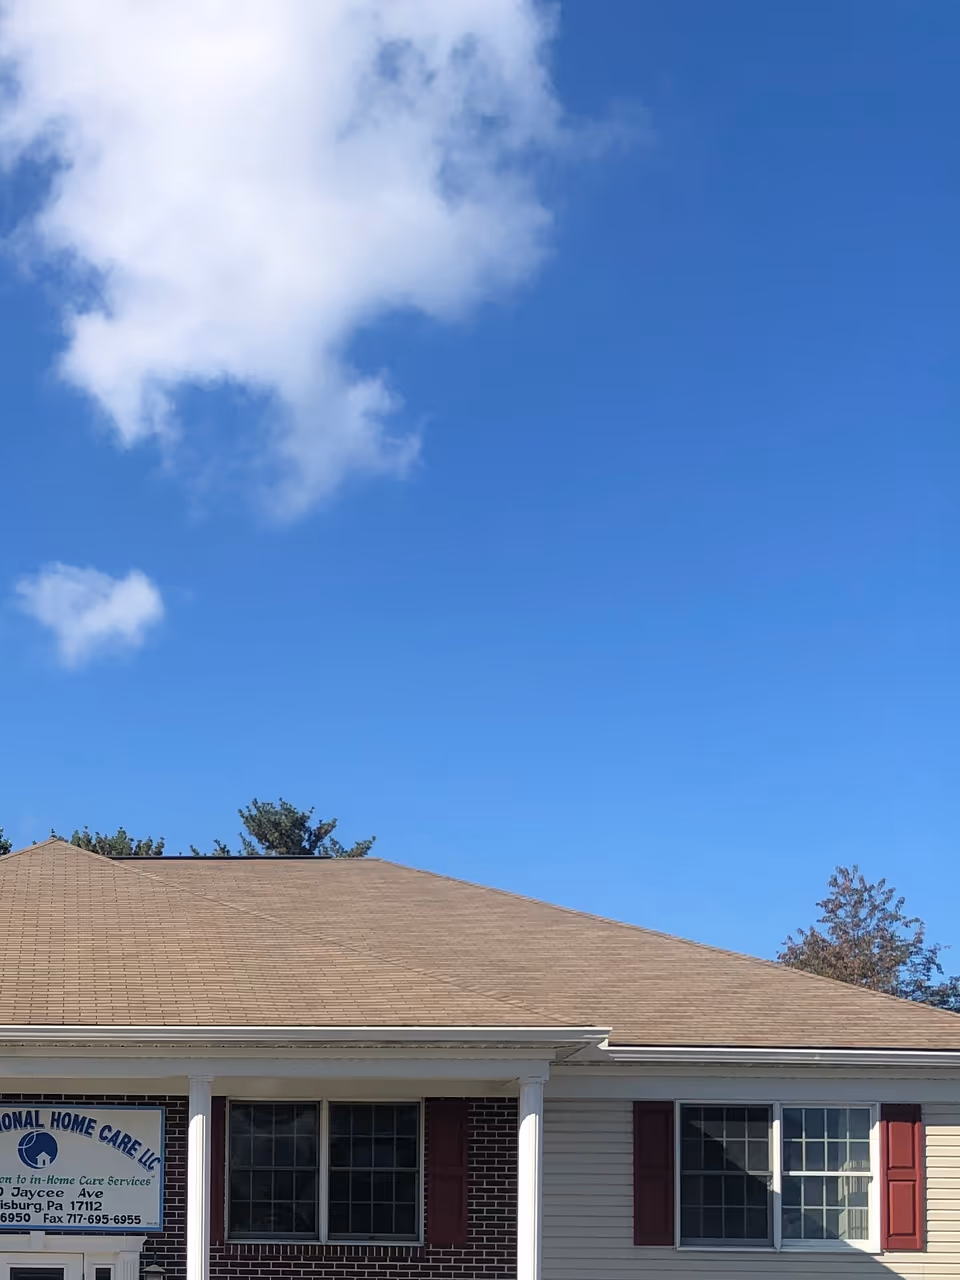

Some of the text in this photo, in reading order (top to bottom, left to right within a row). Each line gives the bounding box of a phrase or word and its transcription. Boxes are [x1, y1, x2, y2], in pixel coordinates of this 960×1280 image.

[49, 1111, 97, 1138] HOME
[137, 1148, 162, 1172] LLC
[16, 1174, 27, 1185] to
[30, 1174, 76, 1185] in-Home
[79, 1175, 105, 1186] Care
[11, 1186, 65, 1200] Jaycee
[77, 1187, 104, 1199] Ave
[47, 1200, 64, 1211] Pa
[70, 1201, 103, 1211] 17112
[43, 1213, 64, 1224] Fax
[66, 1213, 142, 1225] 717-695-6955
